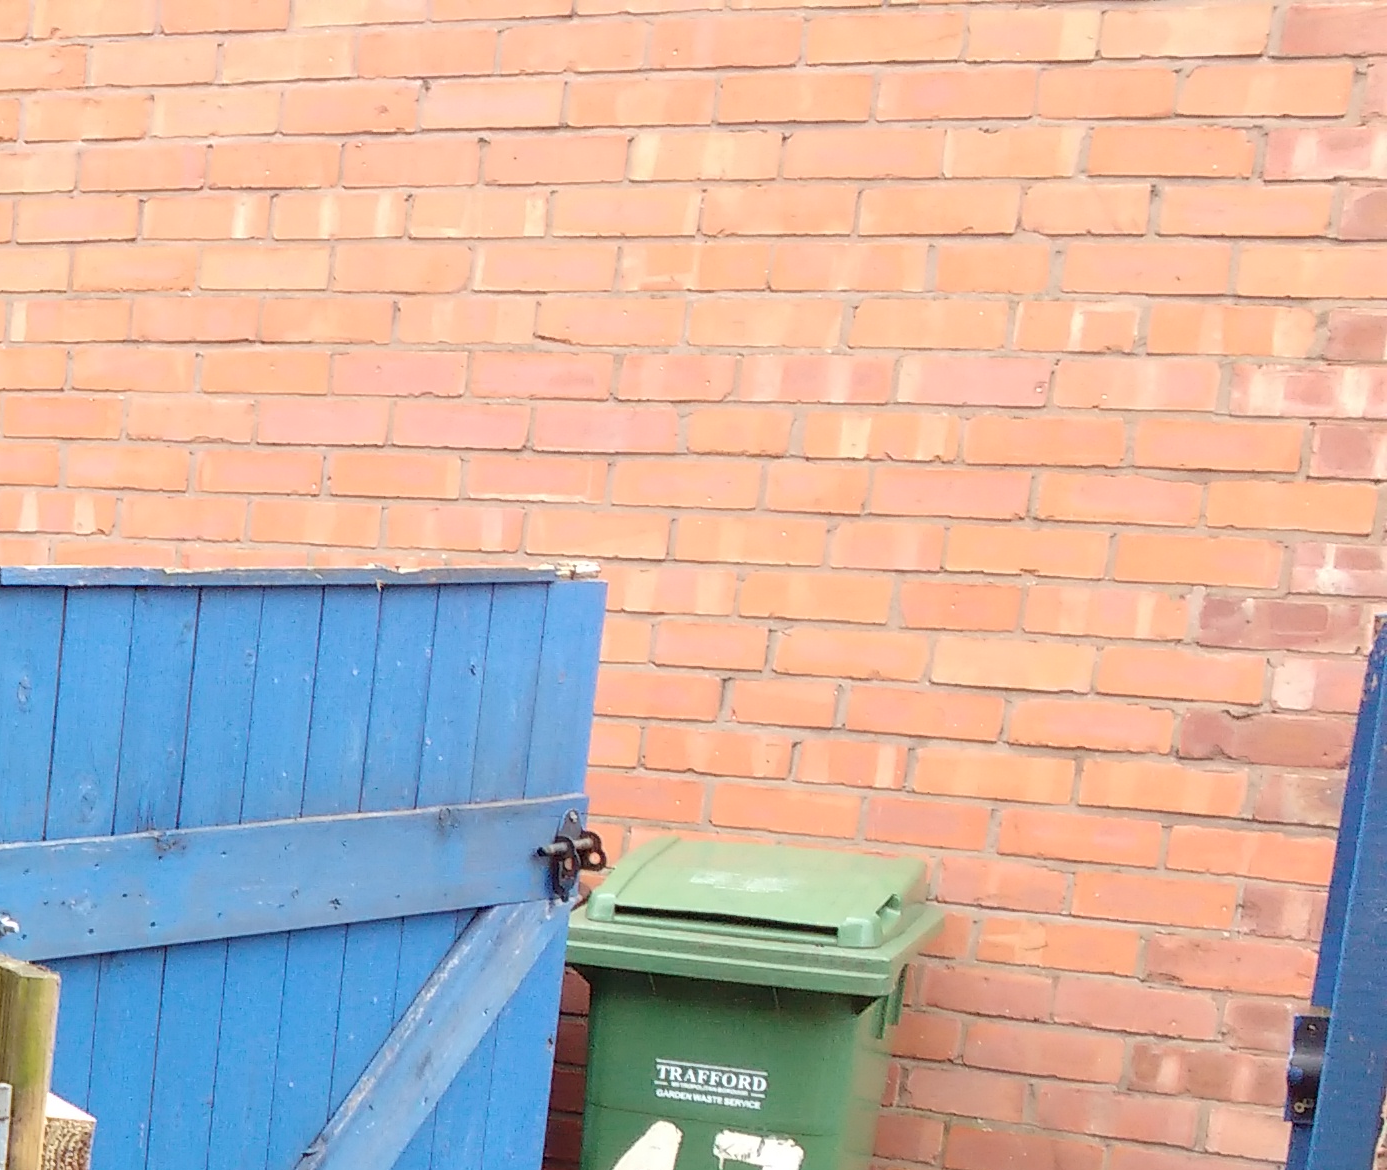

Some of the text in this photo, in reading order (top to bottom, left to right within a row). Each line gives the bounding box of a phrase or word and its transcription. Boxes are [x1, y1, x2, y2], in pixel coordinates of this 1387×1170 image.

[655, 1064, 768, 1092] TRAFFORD
[656, 1088, 761, 1110] GARDEN WASTE SERVICE
